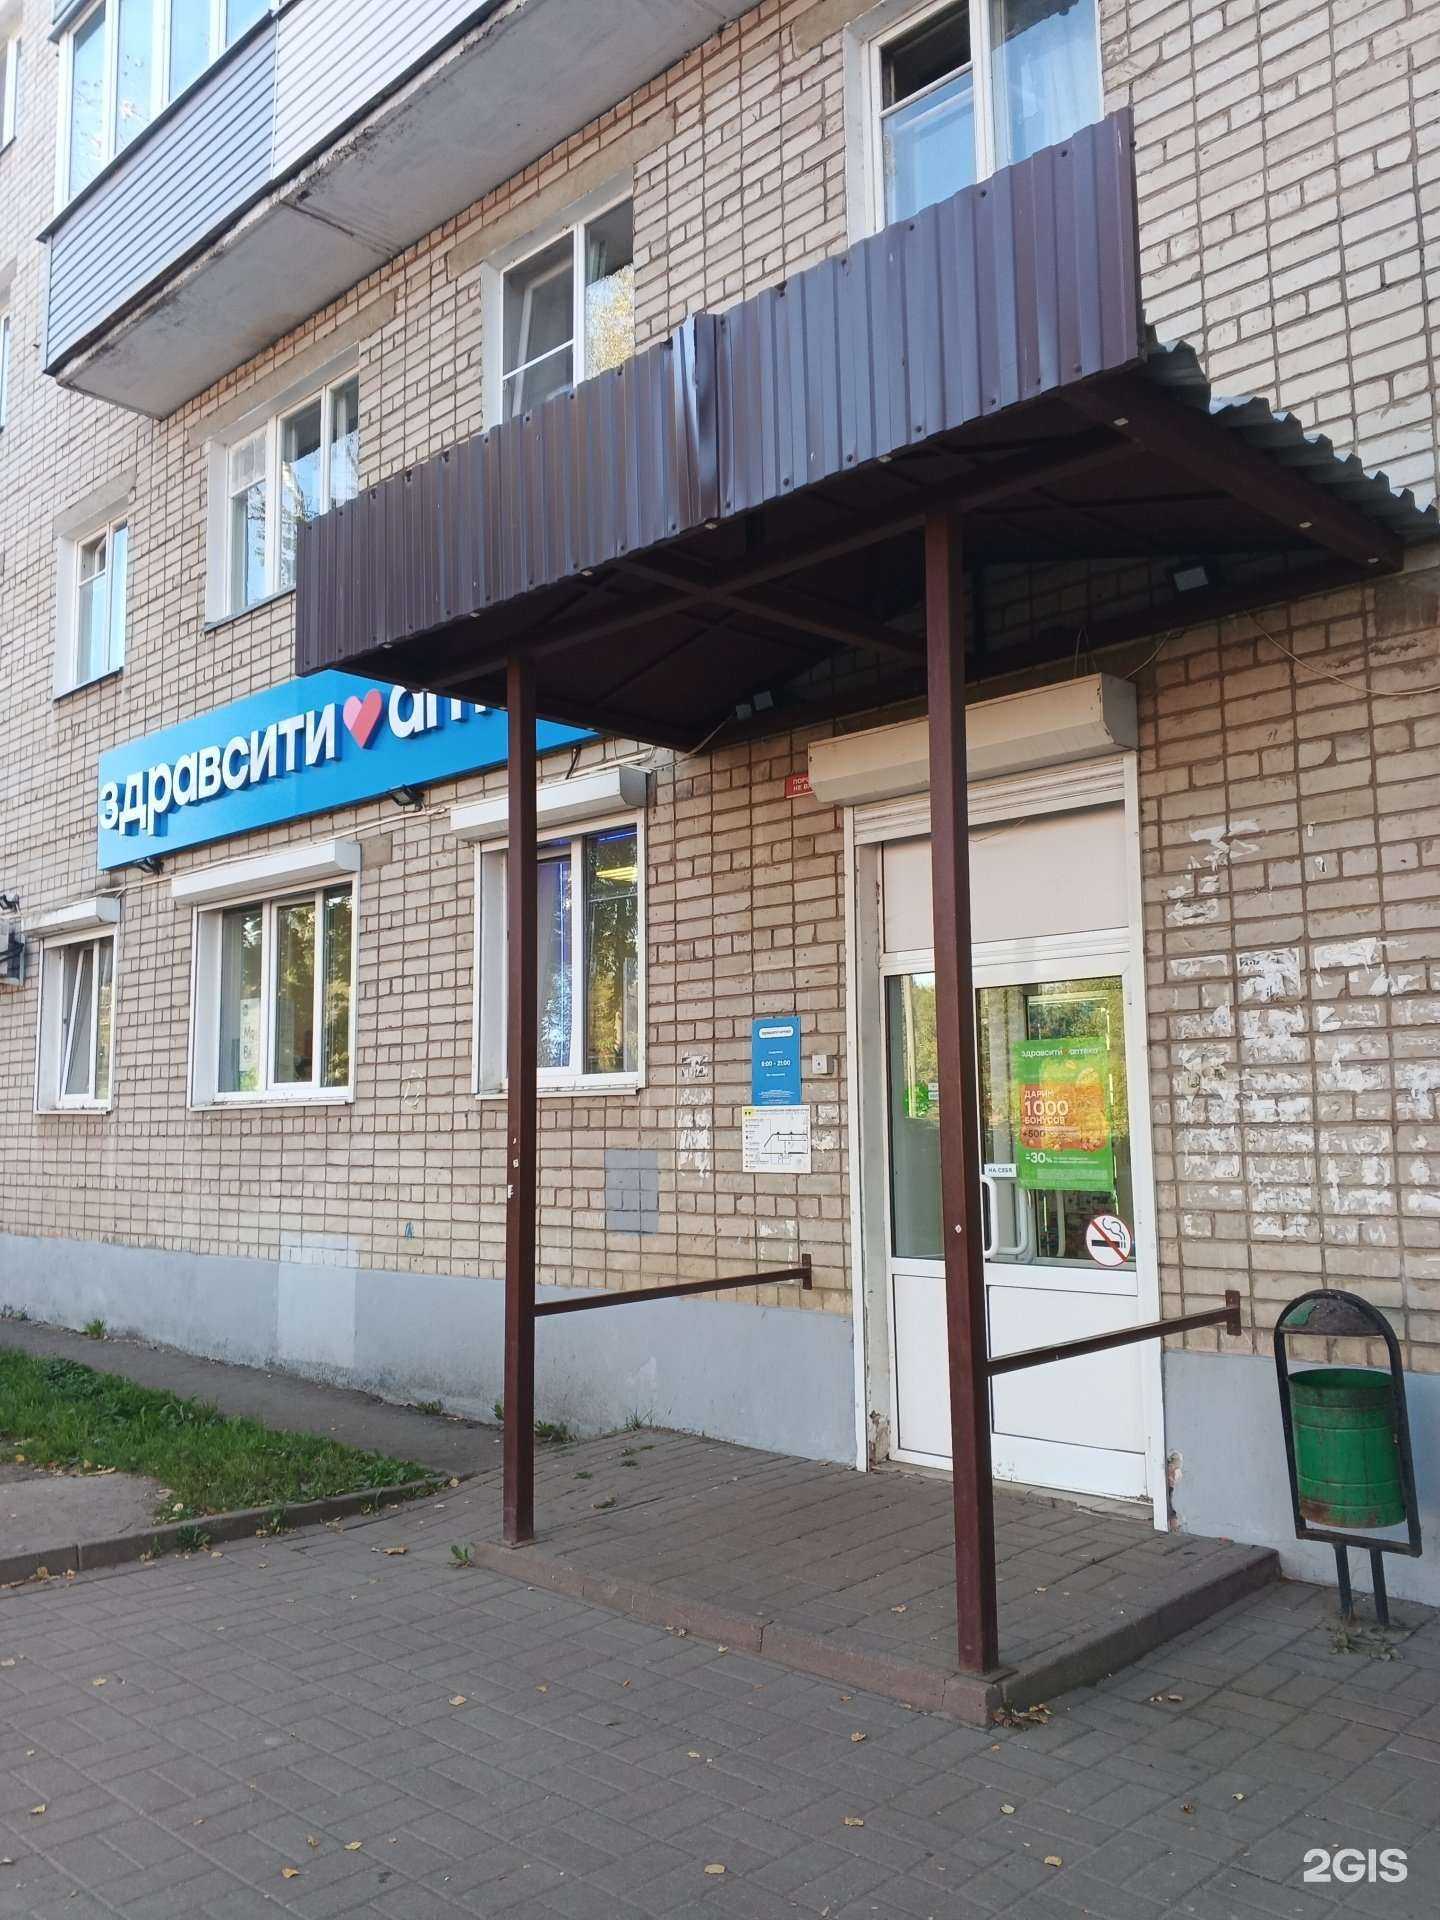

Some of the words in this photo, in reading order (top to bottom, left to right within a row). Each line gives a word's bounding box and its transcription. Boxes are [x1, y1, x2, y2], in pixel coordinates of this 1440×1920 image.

[99, 703, 338, 837] здравсити
[1025, 1100, 1069, 1116] 1000
[1025, 1116, 1066, 1125] БОНУСОВ
